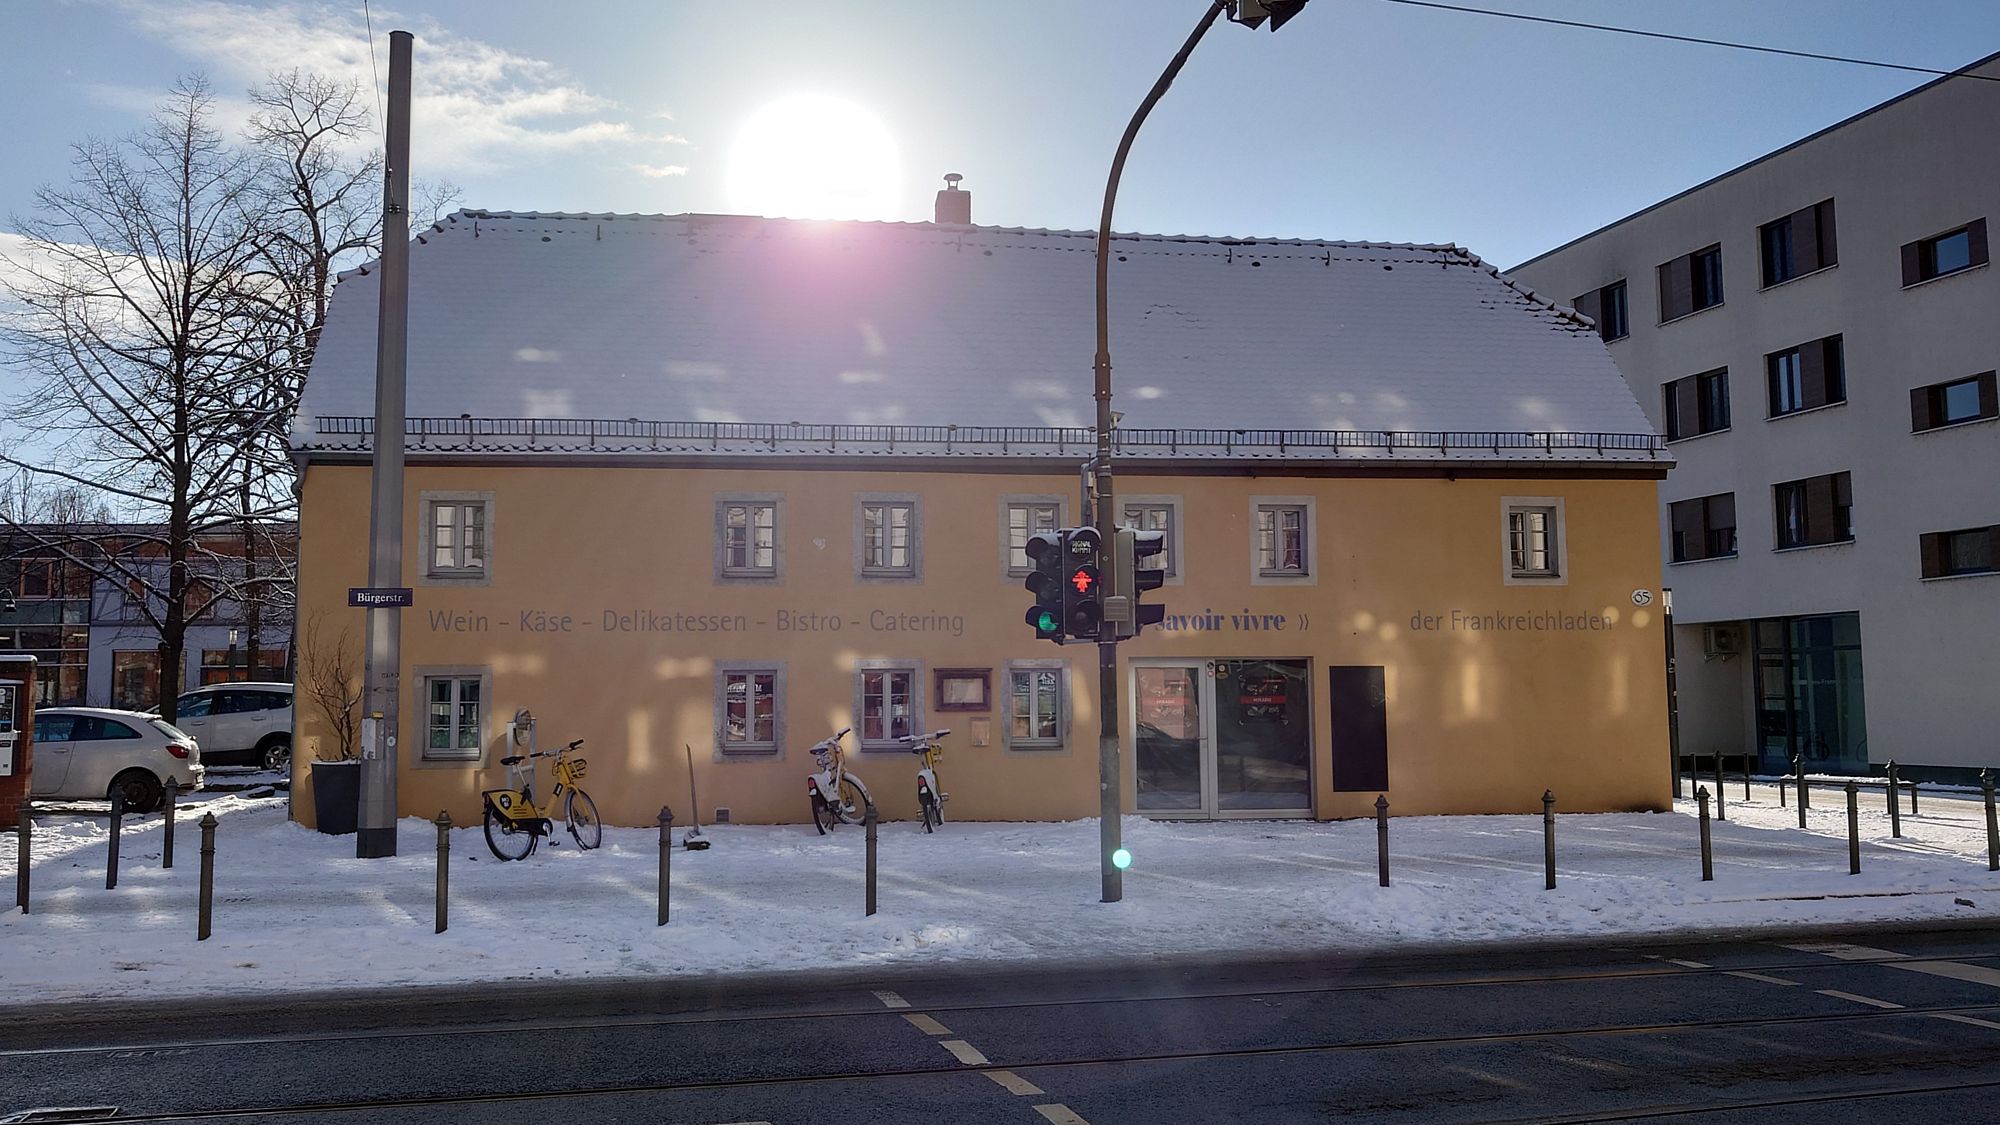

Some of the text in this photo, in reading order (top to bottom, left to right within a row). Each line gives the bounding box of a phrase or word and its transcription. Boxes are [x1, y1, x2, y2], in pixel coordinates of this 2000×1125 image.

[357, 592, 404, 604] Bürgerstr.
[1633, 591, 1651, 604] 65
[429, 609, 488, 632] Wein
[520, 609, 573, 632] Käse
[603, 609, 748, 632] Delikatessen
[777, 609, 842, 632] Bistro
[870, 609, 964, 638] Catering
[1231, 607, 1287, 632] vivre
[1410, 609, 1613, 632] der Frankreichladen
